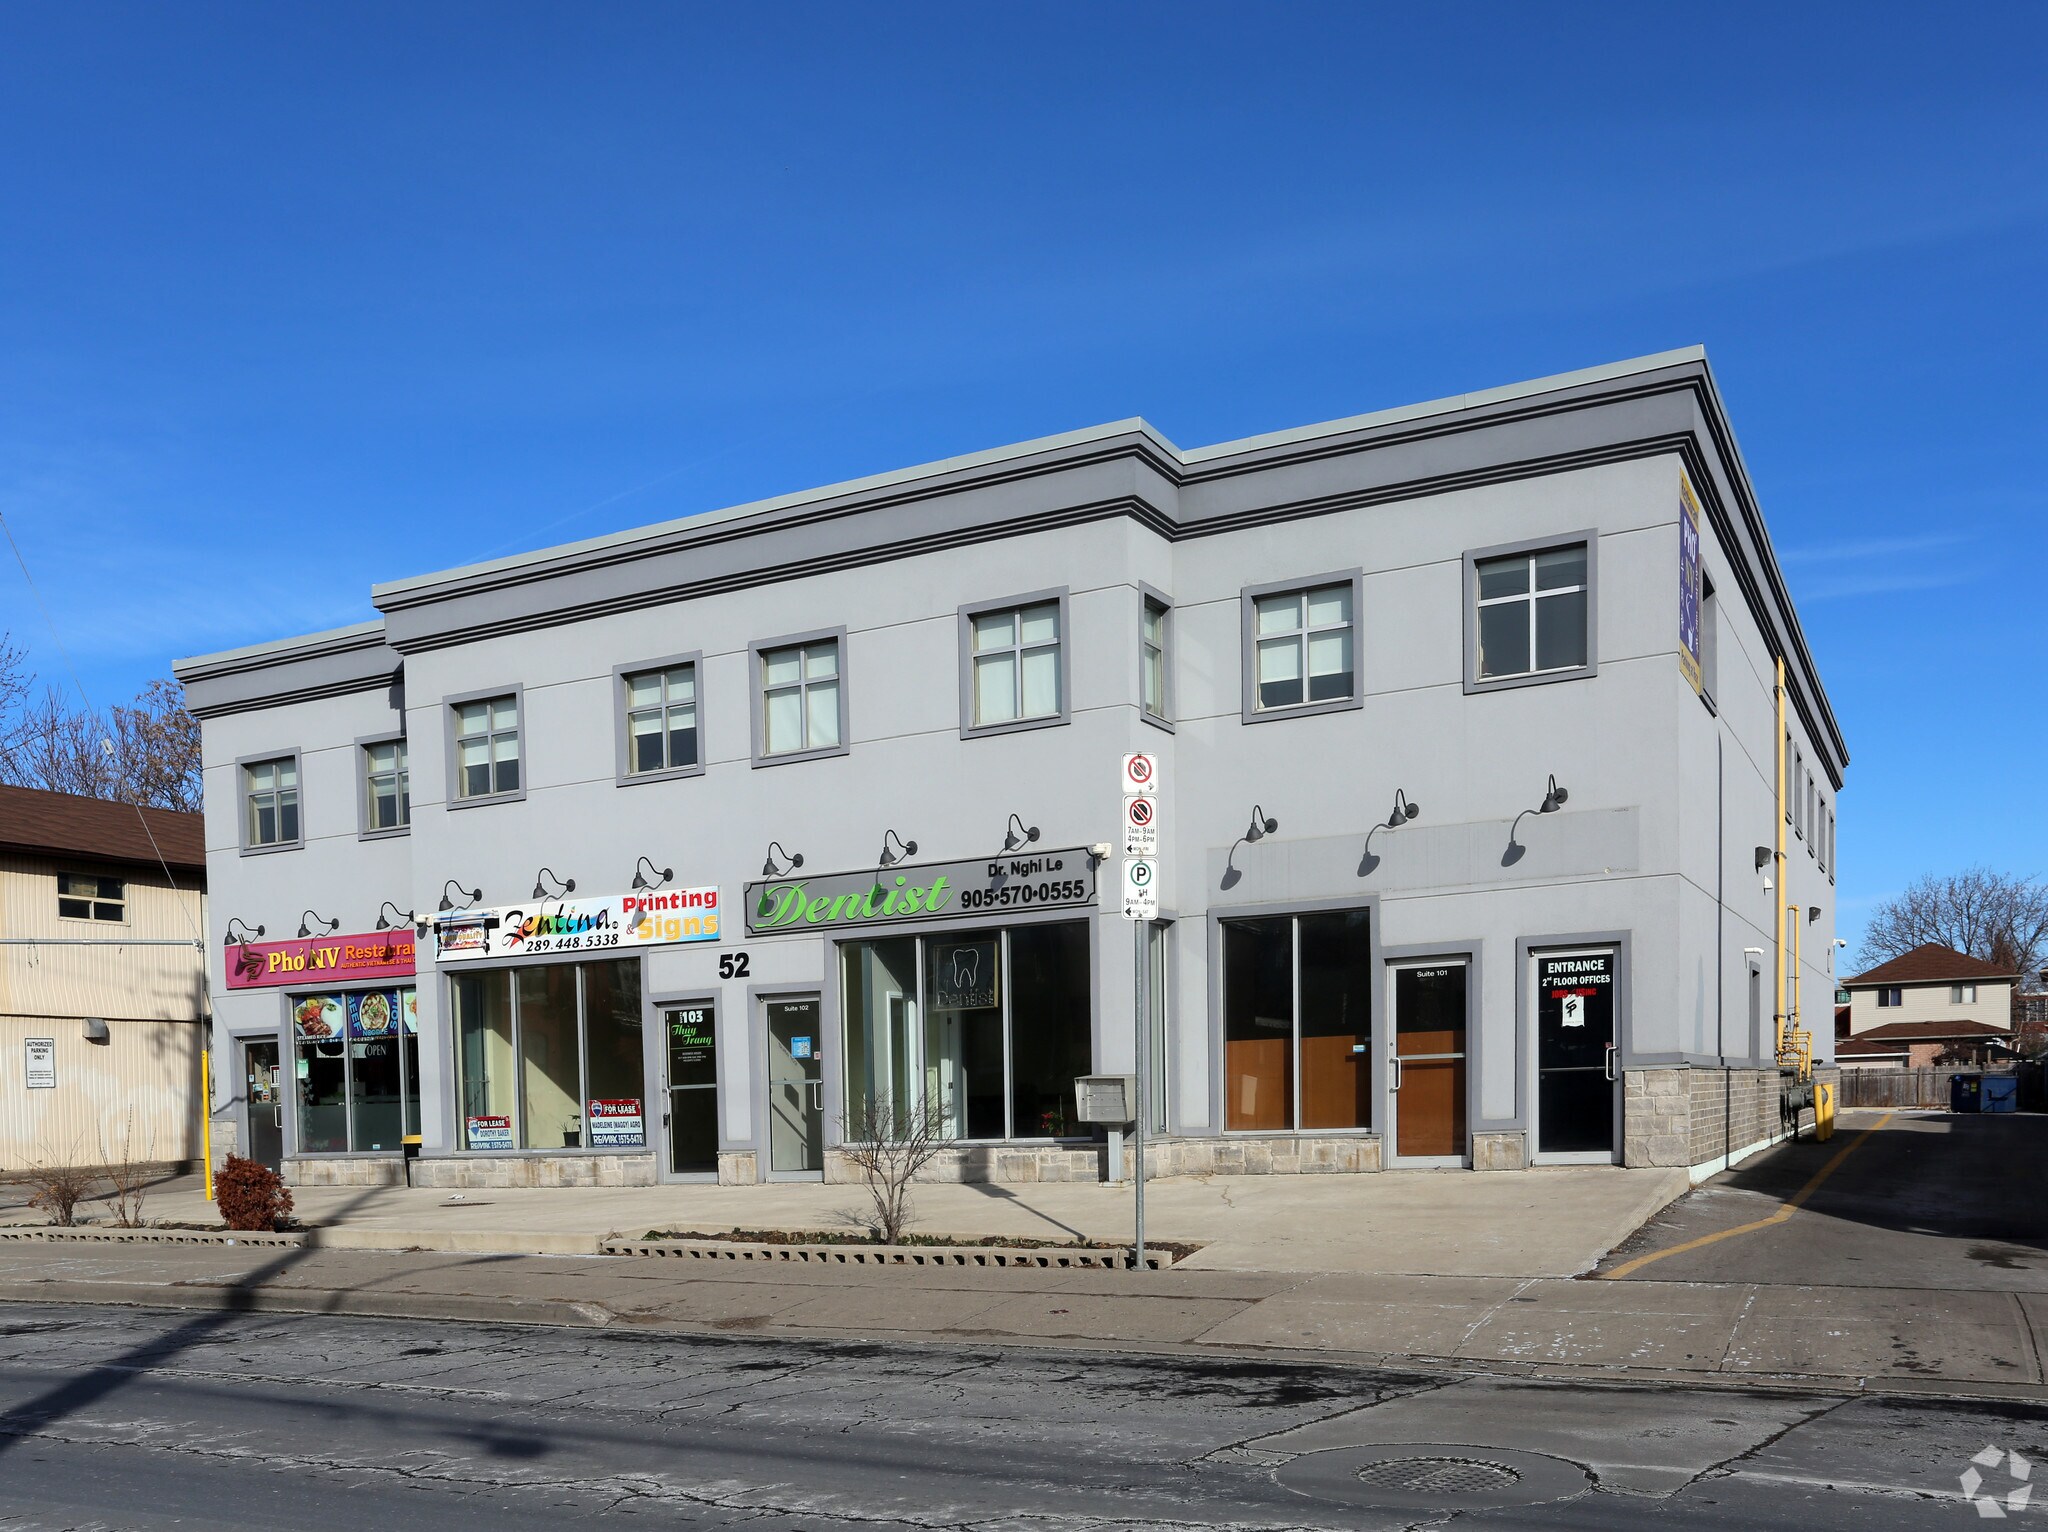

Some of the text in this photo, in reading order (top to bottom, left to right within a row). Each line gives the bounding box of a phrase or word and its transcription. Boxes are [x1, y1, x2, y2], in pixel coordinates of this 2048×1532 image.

[988, 858, 1063, 878] Dr. Nghi Le
[622, 890, 717, 913] Printing
[755, 876, 953, 929] Dentist
[637, 914, 719, 941] Signs
[525, 934, 619, 953] 289.448.5338
[308, 946, 341, 970] NV
[340, 961, 366, 969] AUTHENTIC
[718, 952, 750, 979] 52
[1547, 959, 1605, 974] ENTRANCE
[1416, 970, 1435, 978] Suite
[1553, 976, 1578, 986] FLOOR
[1579, 974, 1611, 985] OFFICES
[682, 1010, 704, 1023] 103
[682, 1034, 713, 1046] Trang
[366, 1044, 387, 1056] OPEN
[604, 1105, 617, 1113] FOR
[617, 1105, 636, 1113] LEASE
[477, 1120, 489, 1128] FOR
[489, 1119, 506, 1127] LEASE
[593, 1134, 618, 1144] RE/MAX
